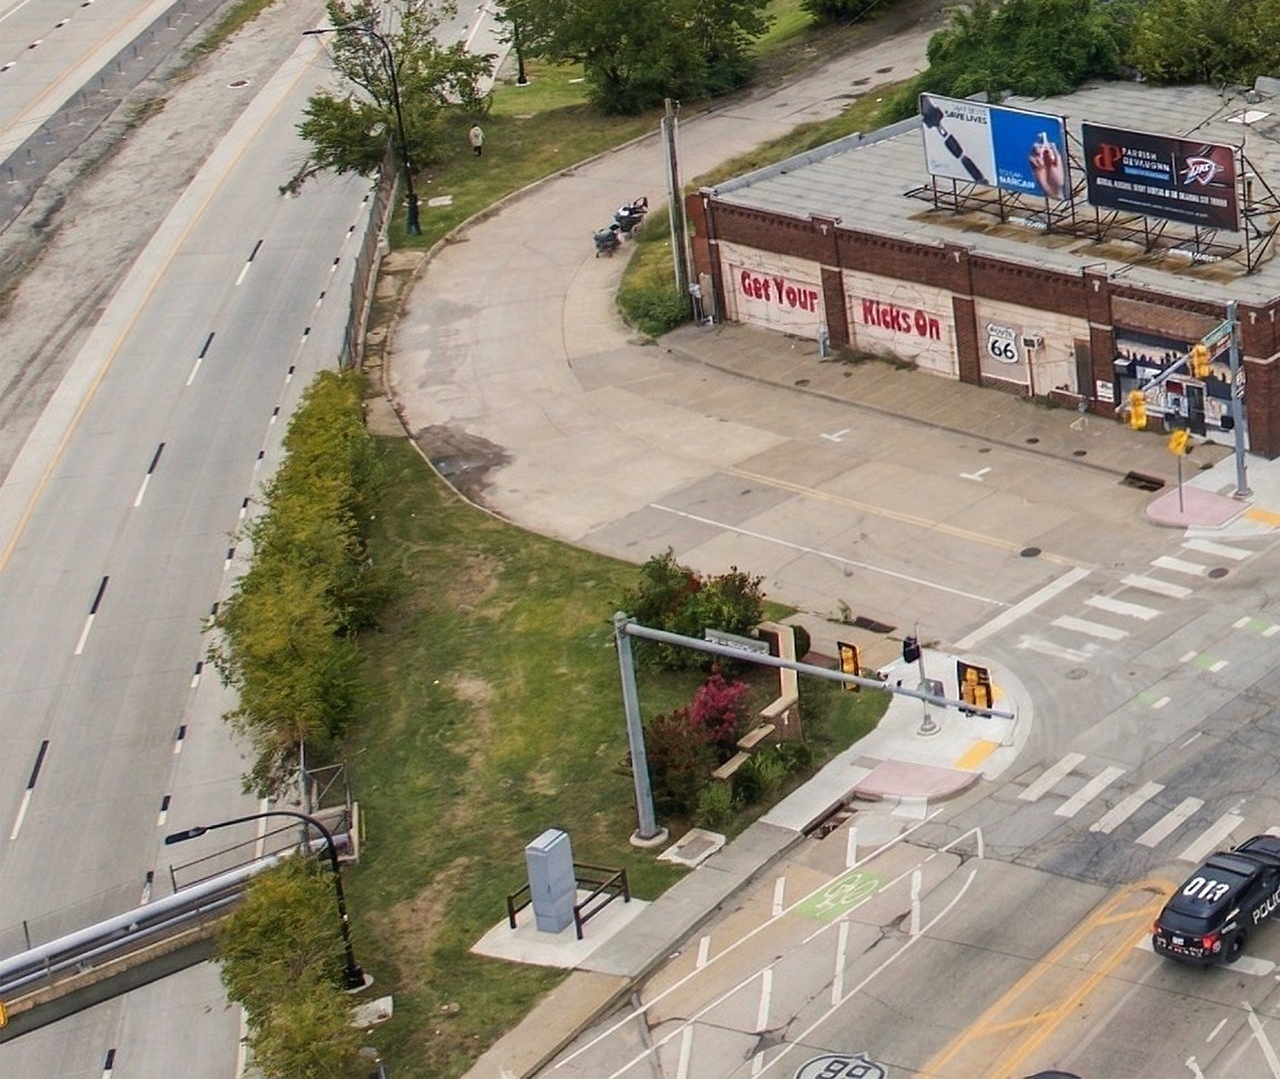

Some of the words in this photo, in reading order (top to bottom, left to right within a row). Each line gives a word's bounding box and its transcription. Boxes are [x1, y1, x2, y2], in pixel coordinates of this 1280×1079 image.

[945, 109, 965, 122] SAVE
[966, 113, 988, 125] LIVES
[1122, 146, 1158, 161] PARRISH
[1122, 157, 1171, 173] DEVAUGHN
[999, 176, 1036, 190] NARCAN
[741, 270, 771, 302] Get
[773, 275, 819, 313] Your
[862, 297, 912, 334] Kicks
[914, 309, 941, 341] On
[989, 324, 1014, 339] ROUTE
[991, 339, 1016, 360] 66
[1183, 876, 1230, 902] 013
